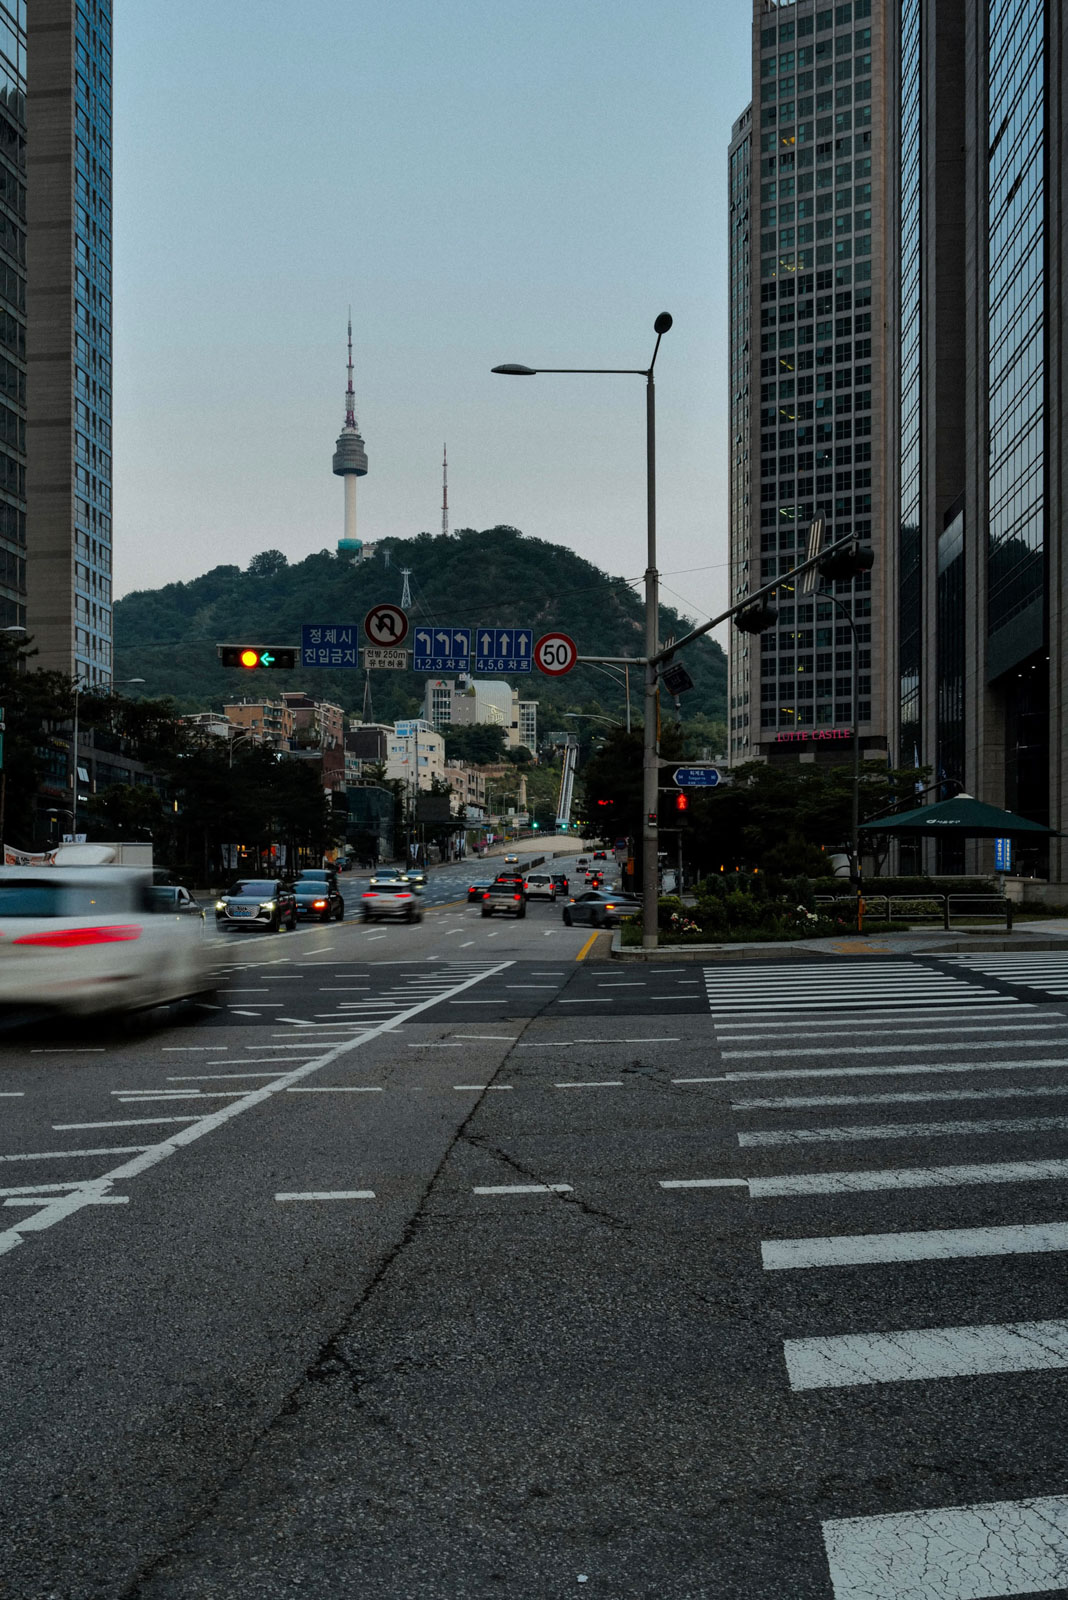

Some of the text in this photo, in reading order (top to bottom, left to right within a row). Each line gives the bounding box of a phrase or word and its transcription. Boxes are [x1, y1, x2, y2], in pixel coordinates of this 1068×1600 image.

[309, 628, 352, 644] 정체시
[305, 648, 355, 664] 진입금지
[367, 650, 406, 659] 전방 250m
[543, 644, 568, 666] 50
[369, 659, 404, 668] 유턴허용
[416, 659, 442, 670] 1,2,3
[477, 660, 504, 671] 4,5,6
[777, 728, 850, 742] LOTTE CASTLE
